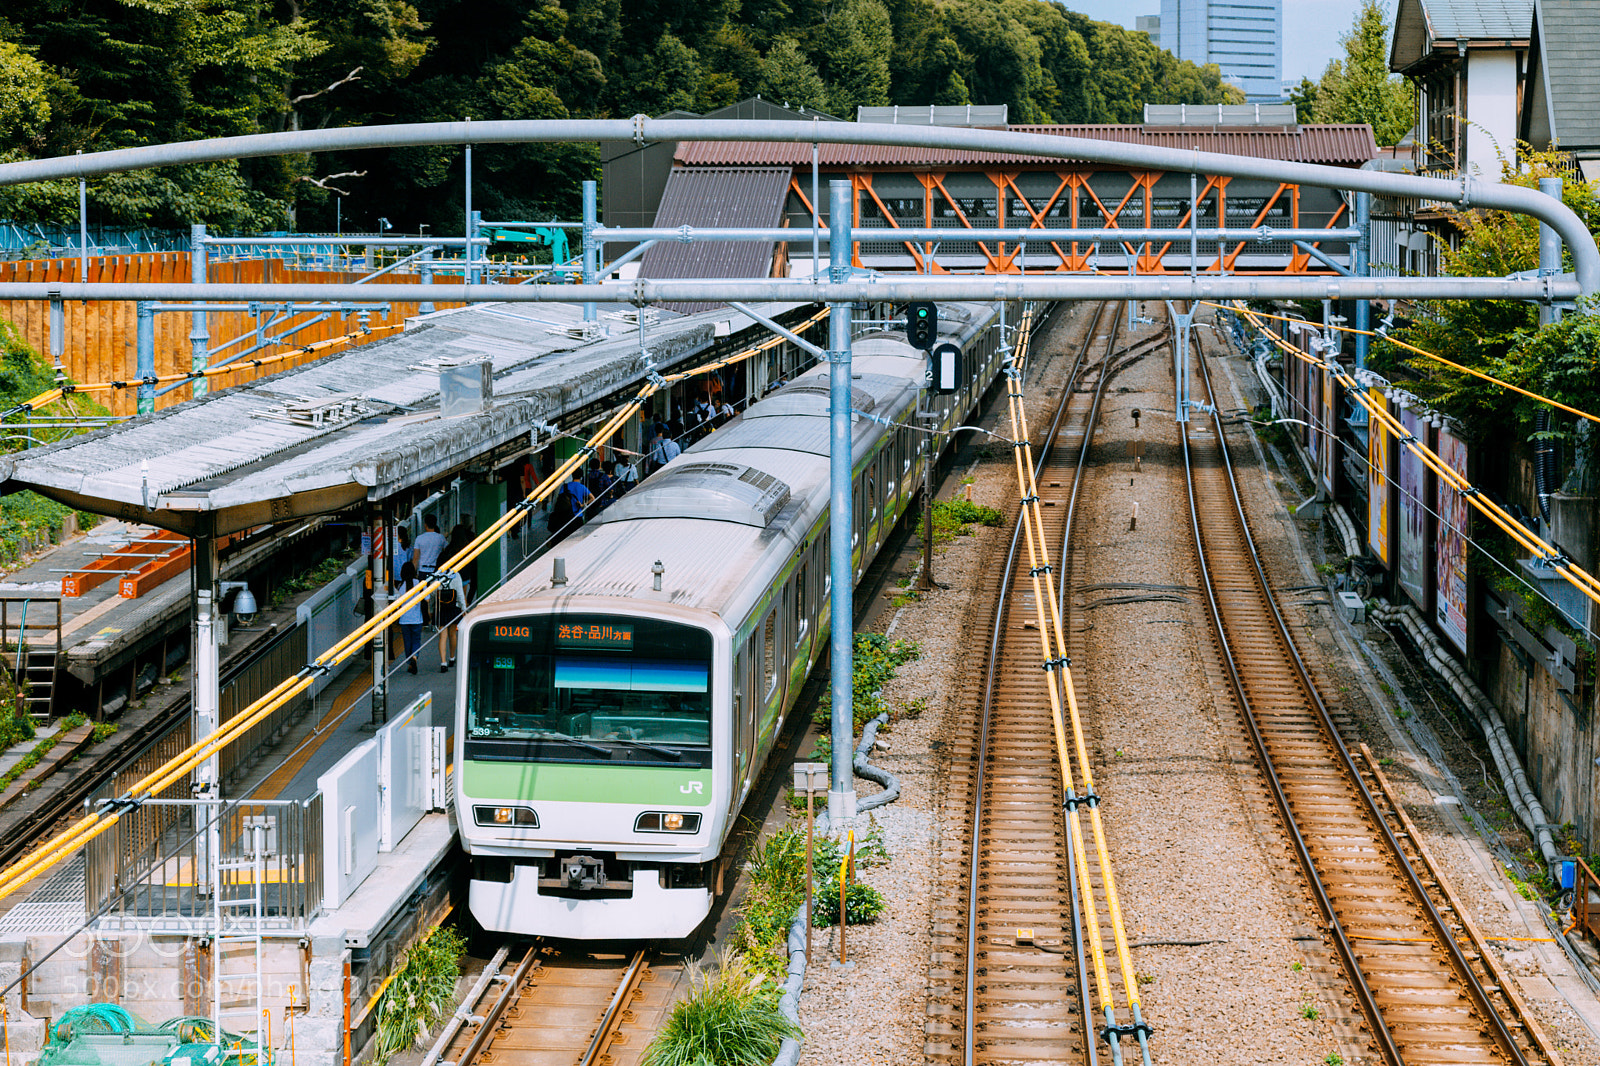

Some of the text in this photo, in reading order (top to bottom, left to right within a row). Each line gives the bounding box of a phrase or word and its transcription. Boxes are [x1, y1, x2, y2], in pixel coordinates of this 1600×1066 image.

[925, 370, 934, 381] 2
[65, 580, 75, 594] 25
[123, 582, 133, 596] 25
[494, 625, 530, 638] 1014G
[495, 656, 513, 668] 539
[472, 727, 490, 736] 539
[679, 780, 703, 795] JR
